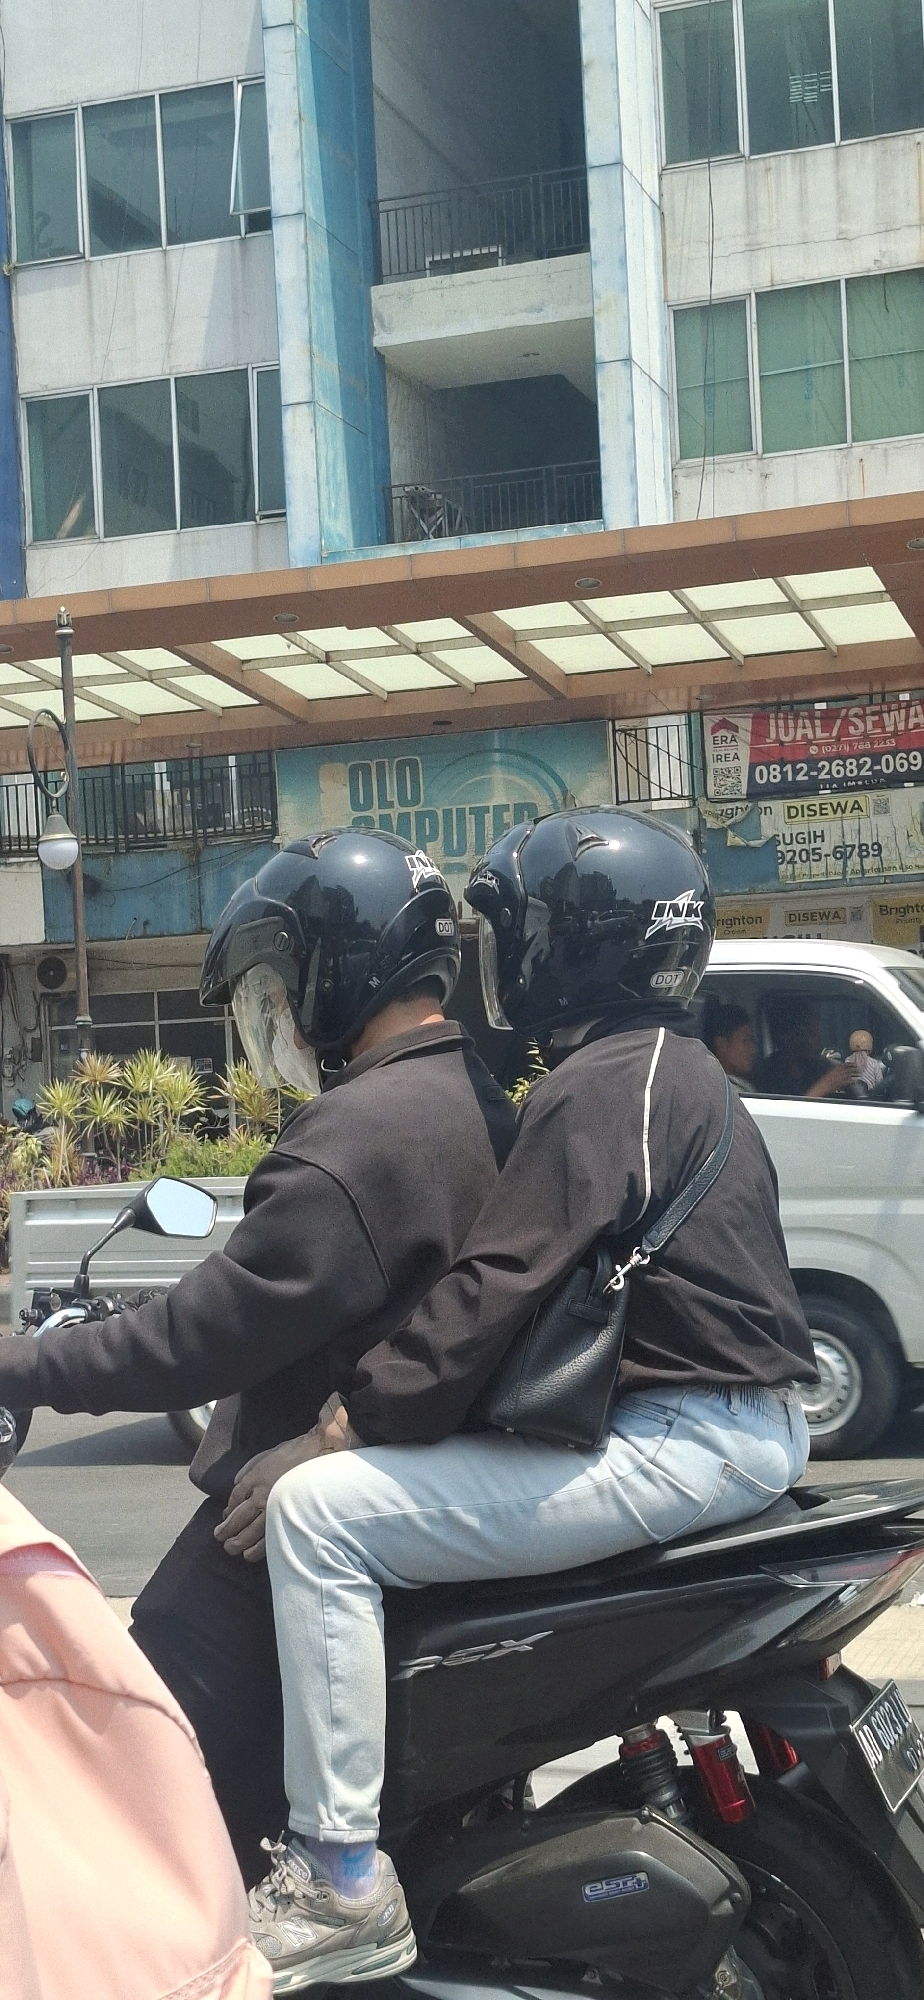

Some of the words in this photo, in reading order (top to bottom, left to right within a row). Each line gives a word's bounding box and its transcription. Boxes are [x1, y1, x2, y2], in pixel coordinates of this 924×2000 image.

[766, 701, 924, 742] JUAL/SEWA
[712, 735, 738, 745] ERA
[712, 752, 740, 763] IREA
[755, 751, 922, 784] 0812-2682-069
[787, 800, 864, 819] DISEWA
[777, 842, 883, 865] 9205-6789
[649, 894, 705, 924] INK
[788, 910, 842, 923] DISEWA
[438, 921, 453, 933] DOT
[716, 914, 763, 929] righton
[655, 975, 679, 985] DOT
[391, 1630, 554, 1682] PCX
[870, 1701, 904, 1750] 6023
